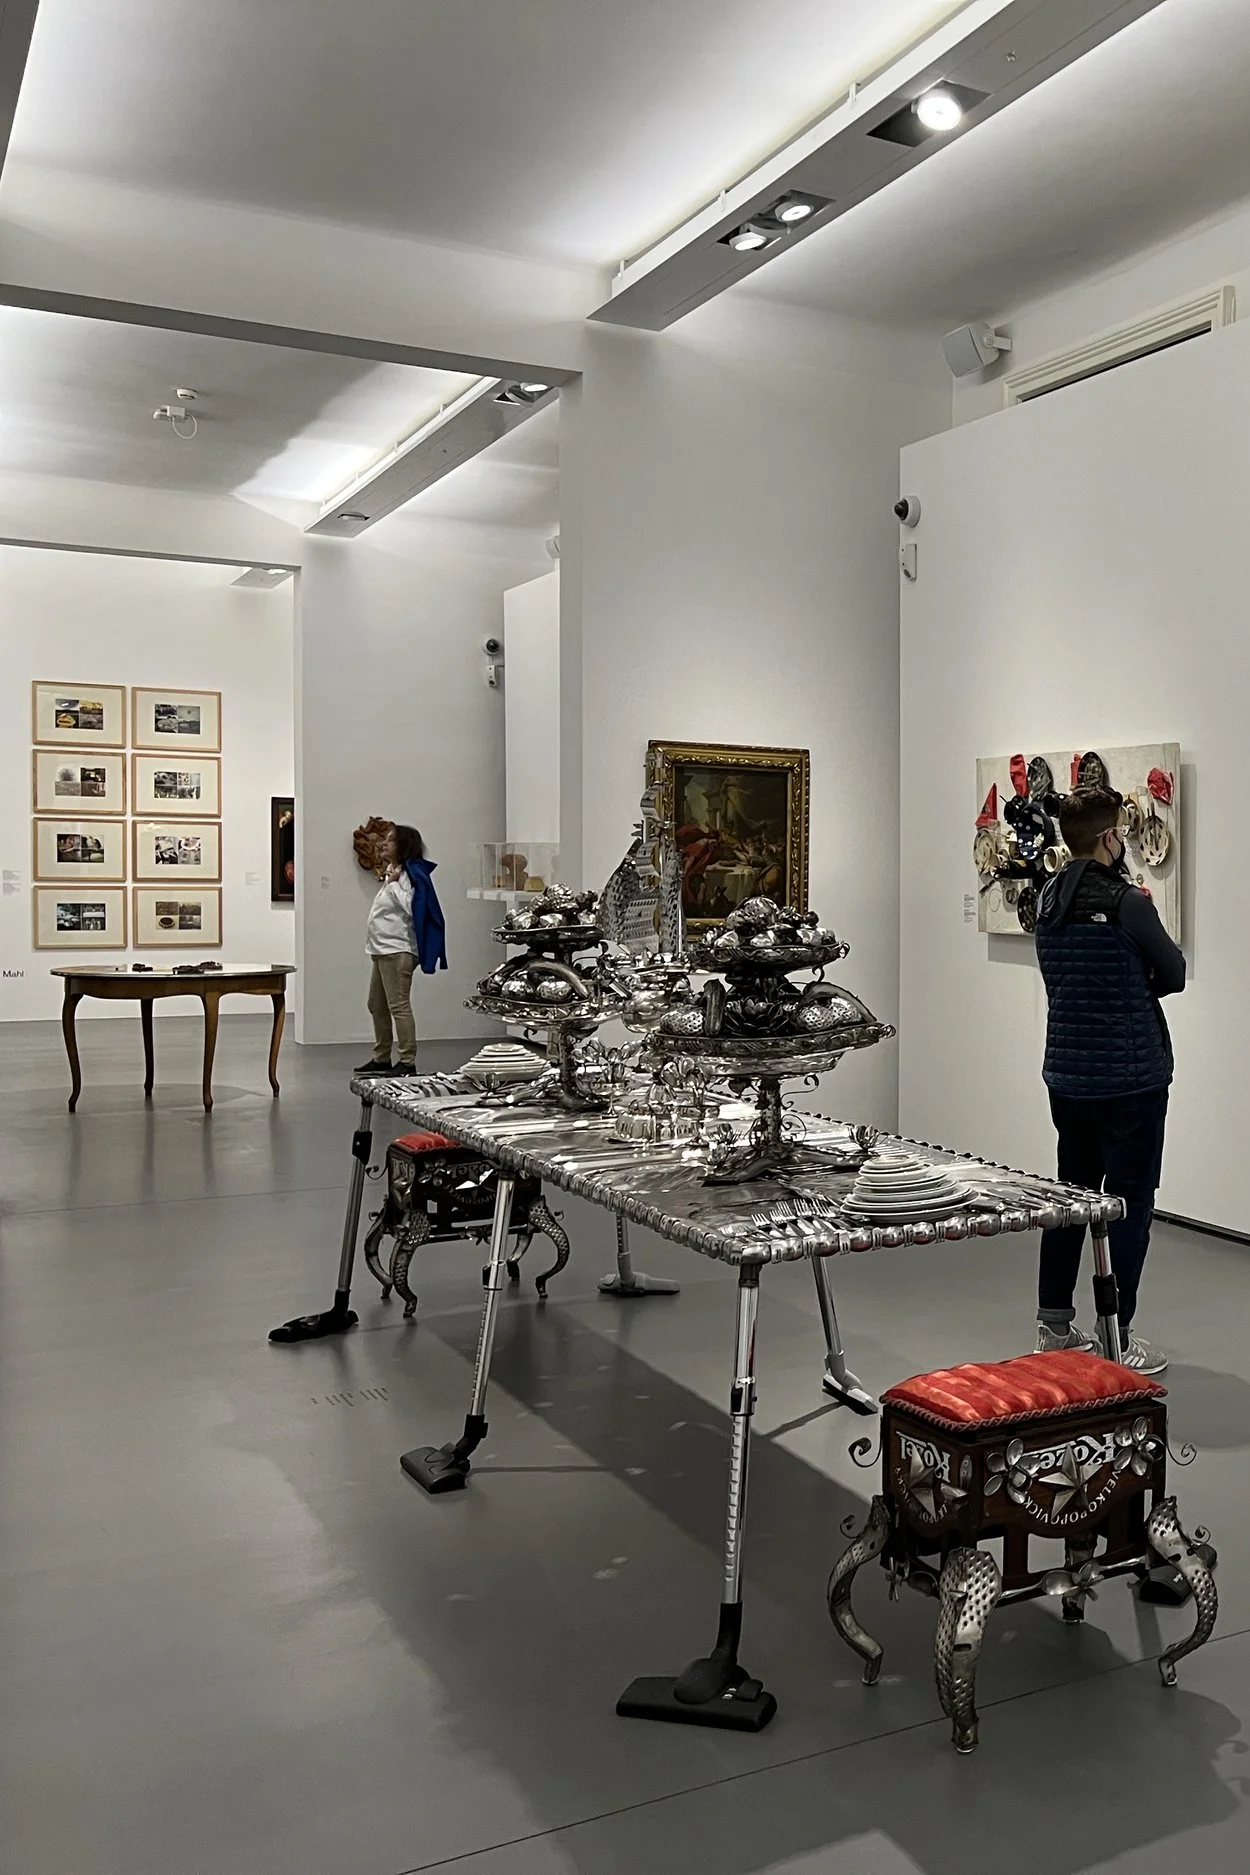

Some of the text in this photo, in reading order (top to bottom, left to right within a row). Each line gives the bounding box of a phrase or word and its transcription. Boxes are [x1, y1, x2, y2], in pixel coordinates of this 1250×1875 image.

[2, 970, 24, 978] Mahl
[1026, 1433, 1116, 1470] Koze
[1022, 1469, 1122, 1525] VELKOPOPOVICK
